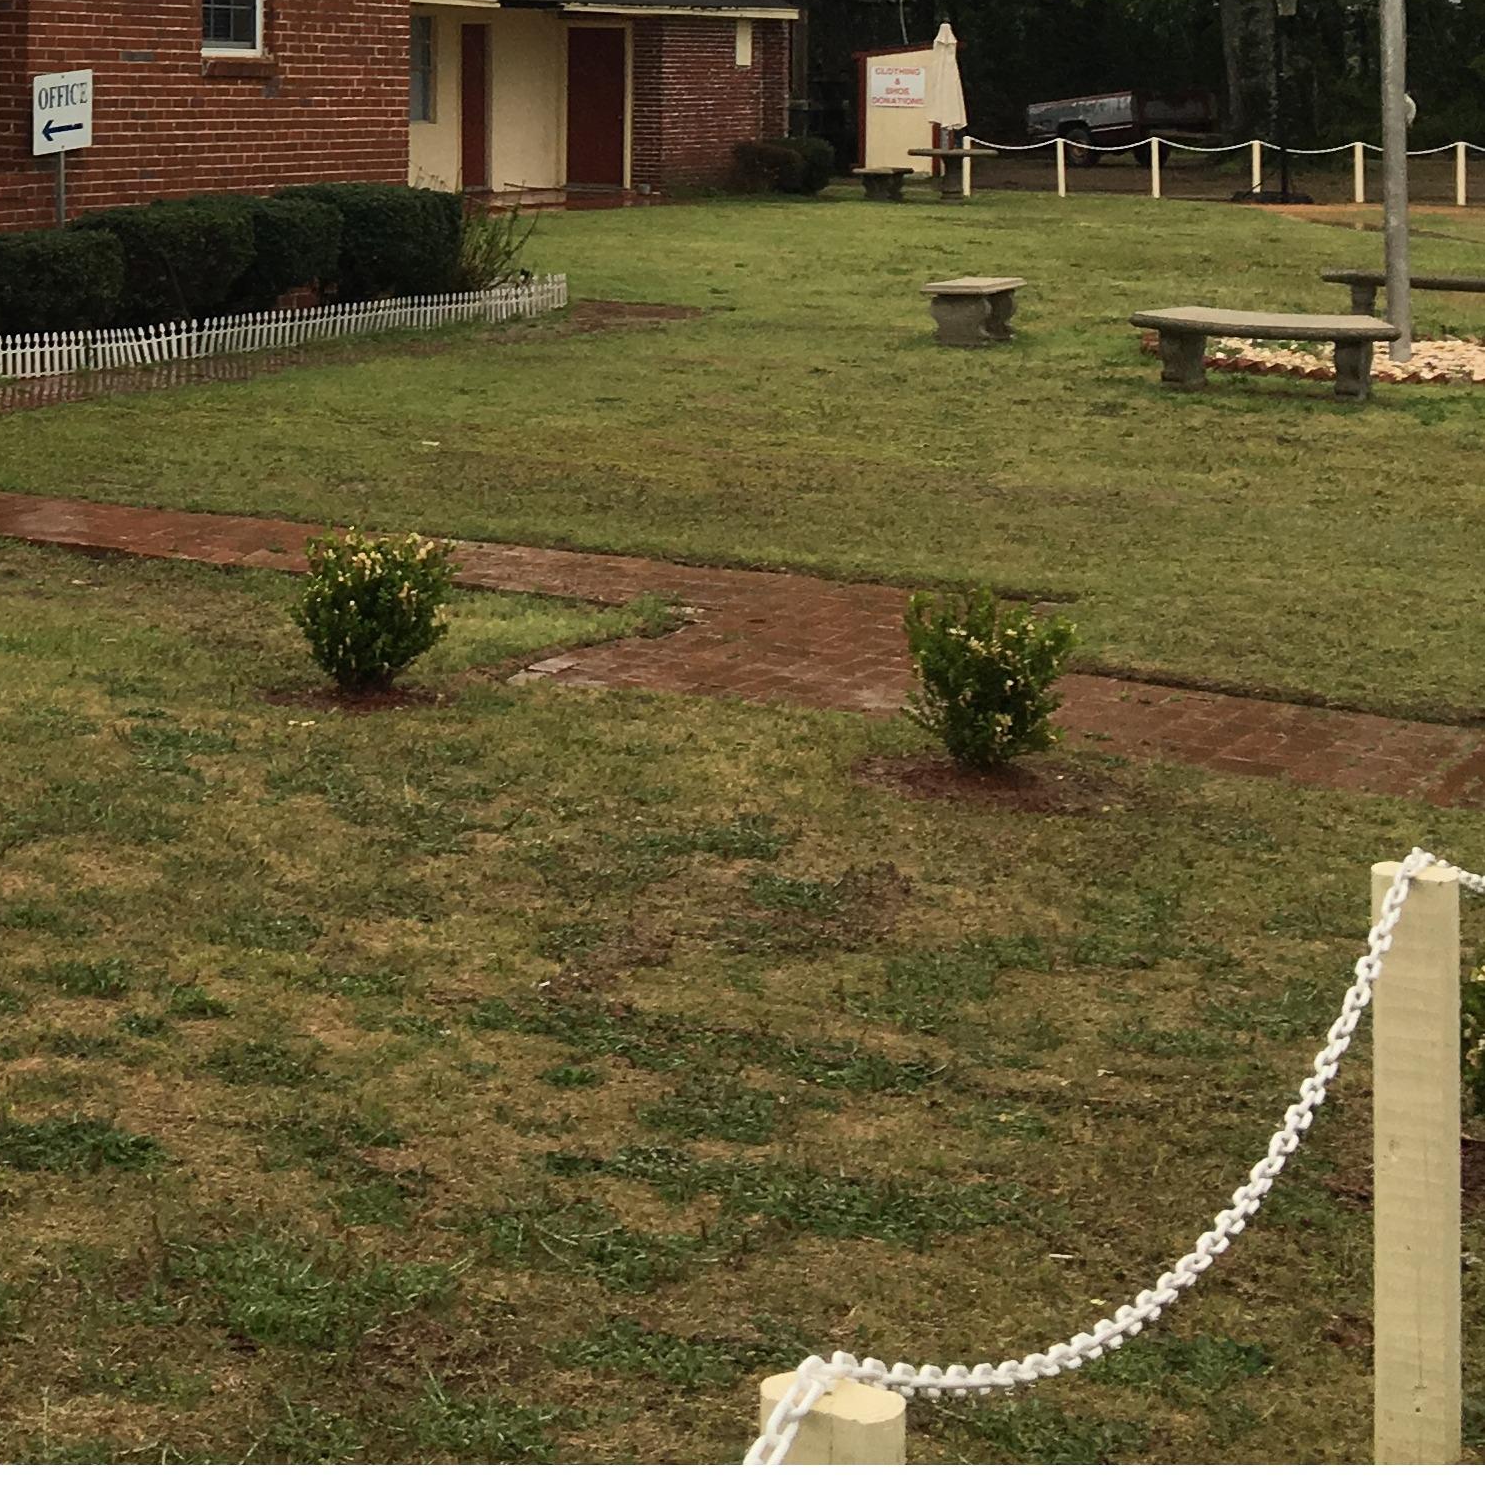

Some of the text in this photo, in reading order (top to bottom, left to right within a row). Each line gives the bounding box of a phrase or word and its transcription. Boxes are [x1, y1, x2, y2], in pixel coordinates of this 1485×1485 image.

[875, 67, 921, 76] CLOTHING
[38, 82, 88, 110] OFFICE
[872, 97, 924, 105] DONATIONS
